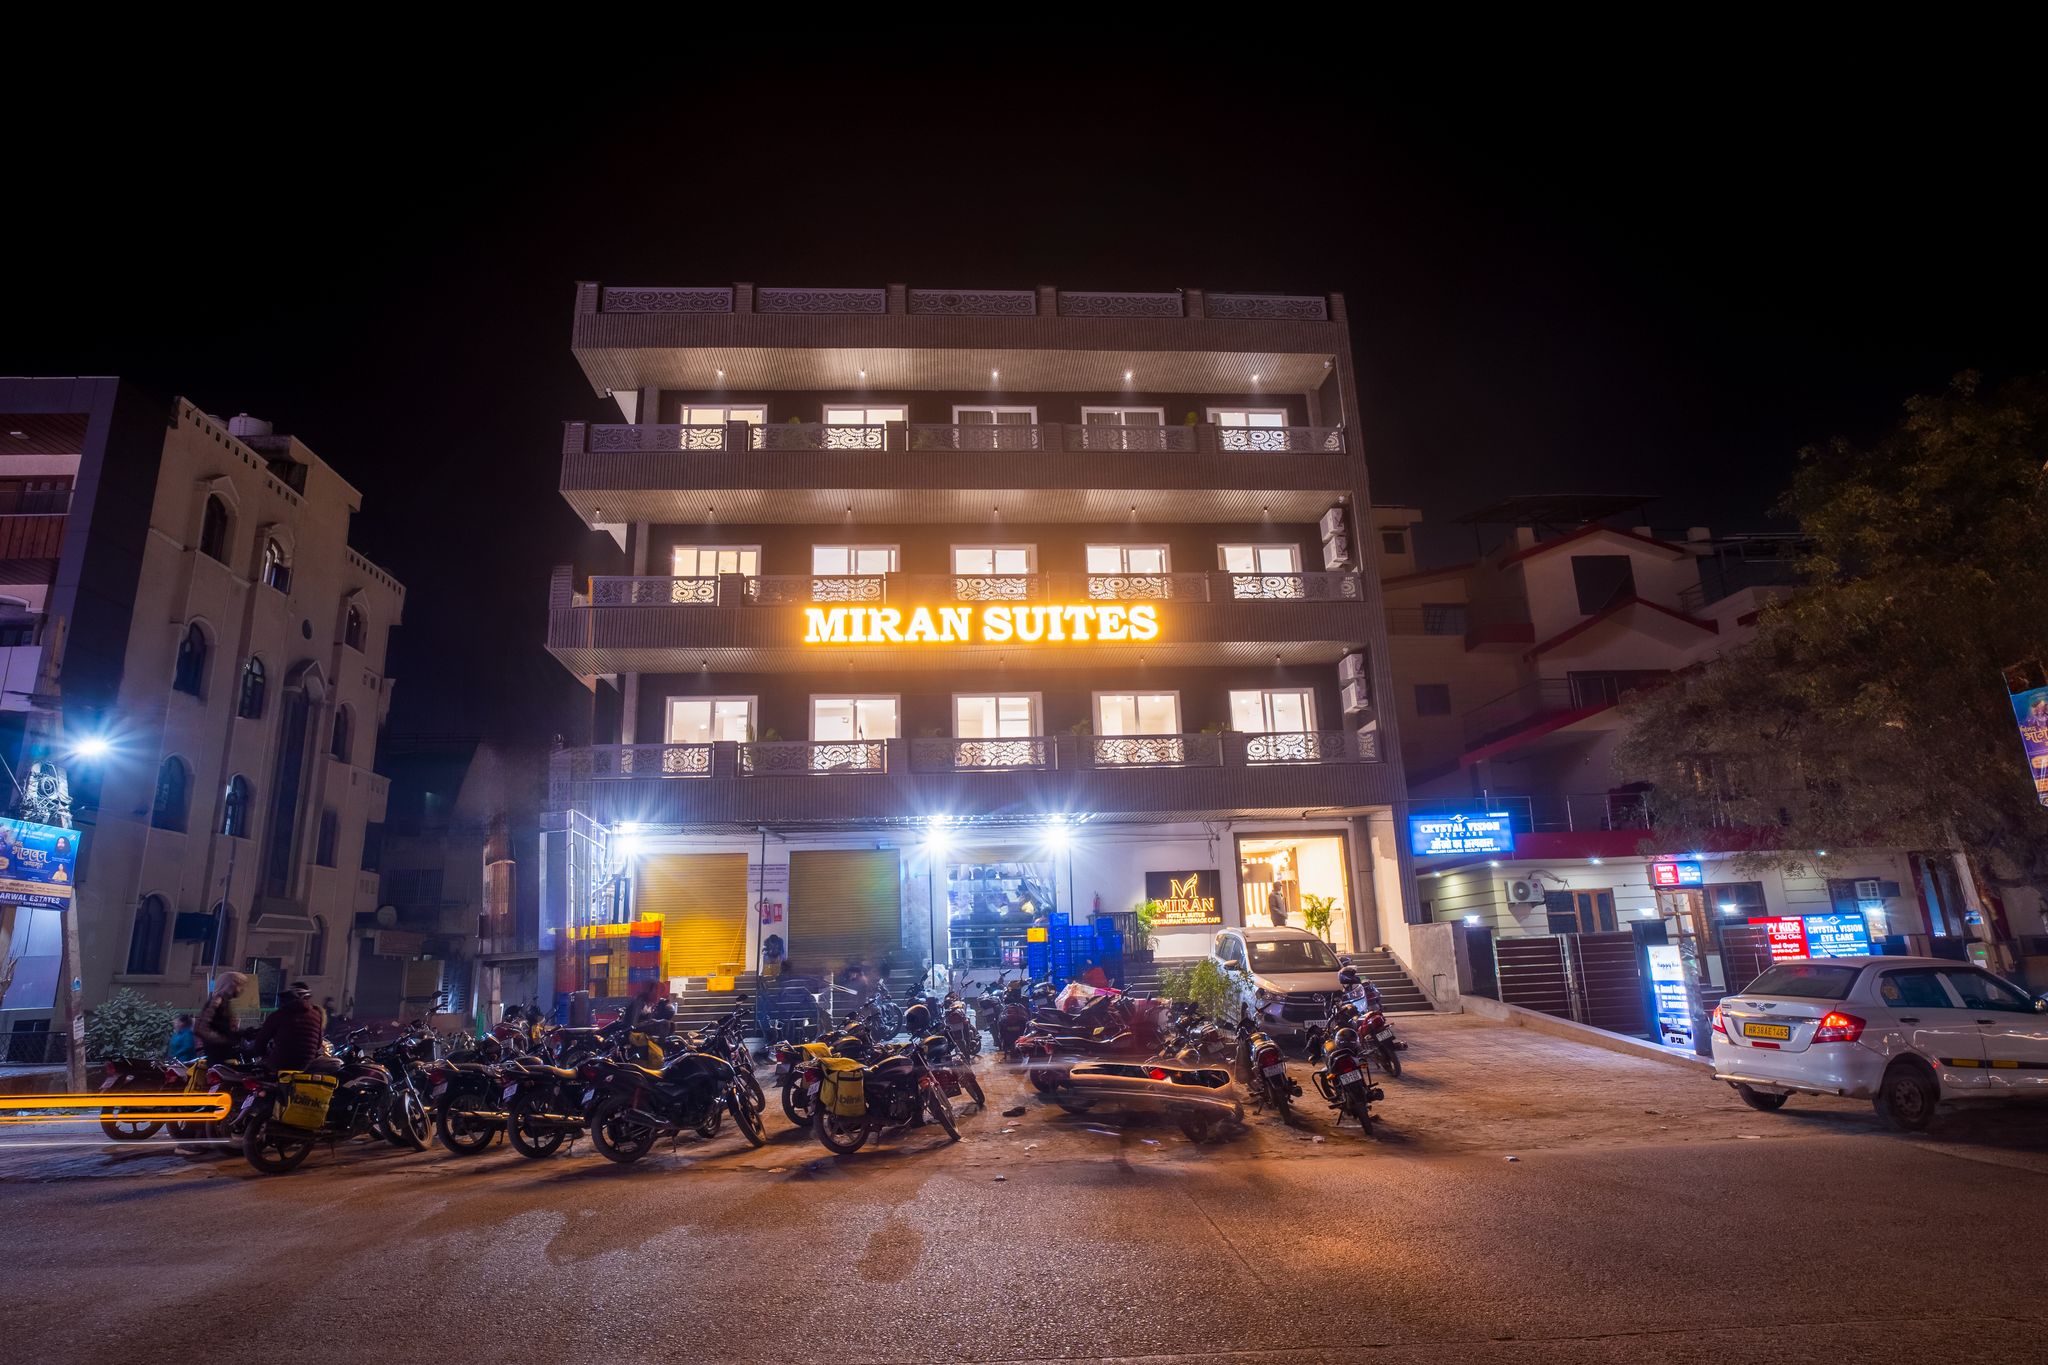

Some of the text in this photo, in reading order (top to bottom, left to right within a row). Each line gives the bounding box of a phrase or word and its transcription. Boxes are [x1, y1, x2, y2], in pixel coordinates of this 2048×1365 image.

[805, 606, 1158, 643] MIRAN SUITES
[1420, 821, 1500, 833] CRYSTAL VISION
[29, 895, 60, 904] ESTATES
[1155, 897, 1215, 913] MIRAN
[1778, 922, 1800, 933] KIDS
[1808, 924, 1864, 934] CRYSTAL VISION
[1820, 933, 1854, 942] EYE CARE
